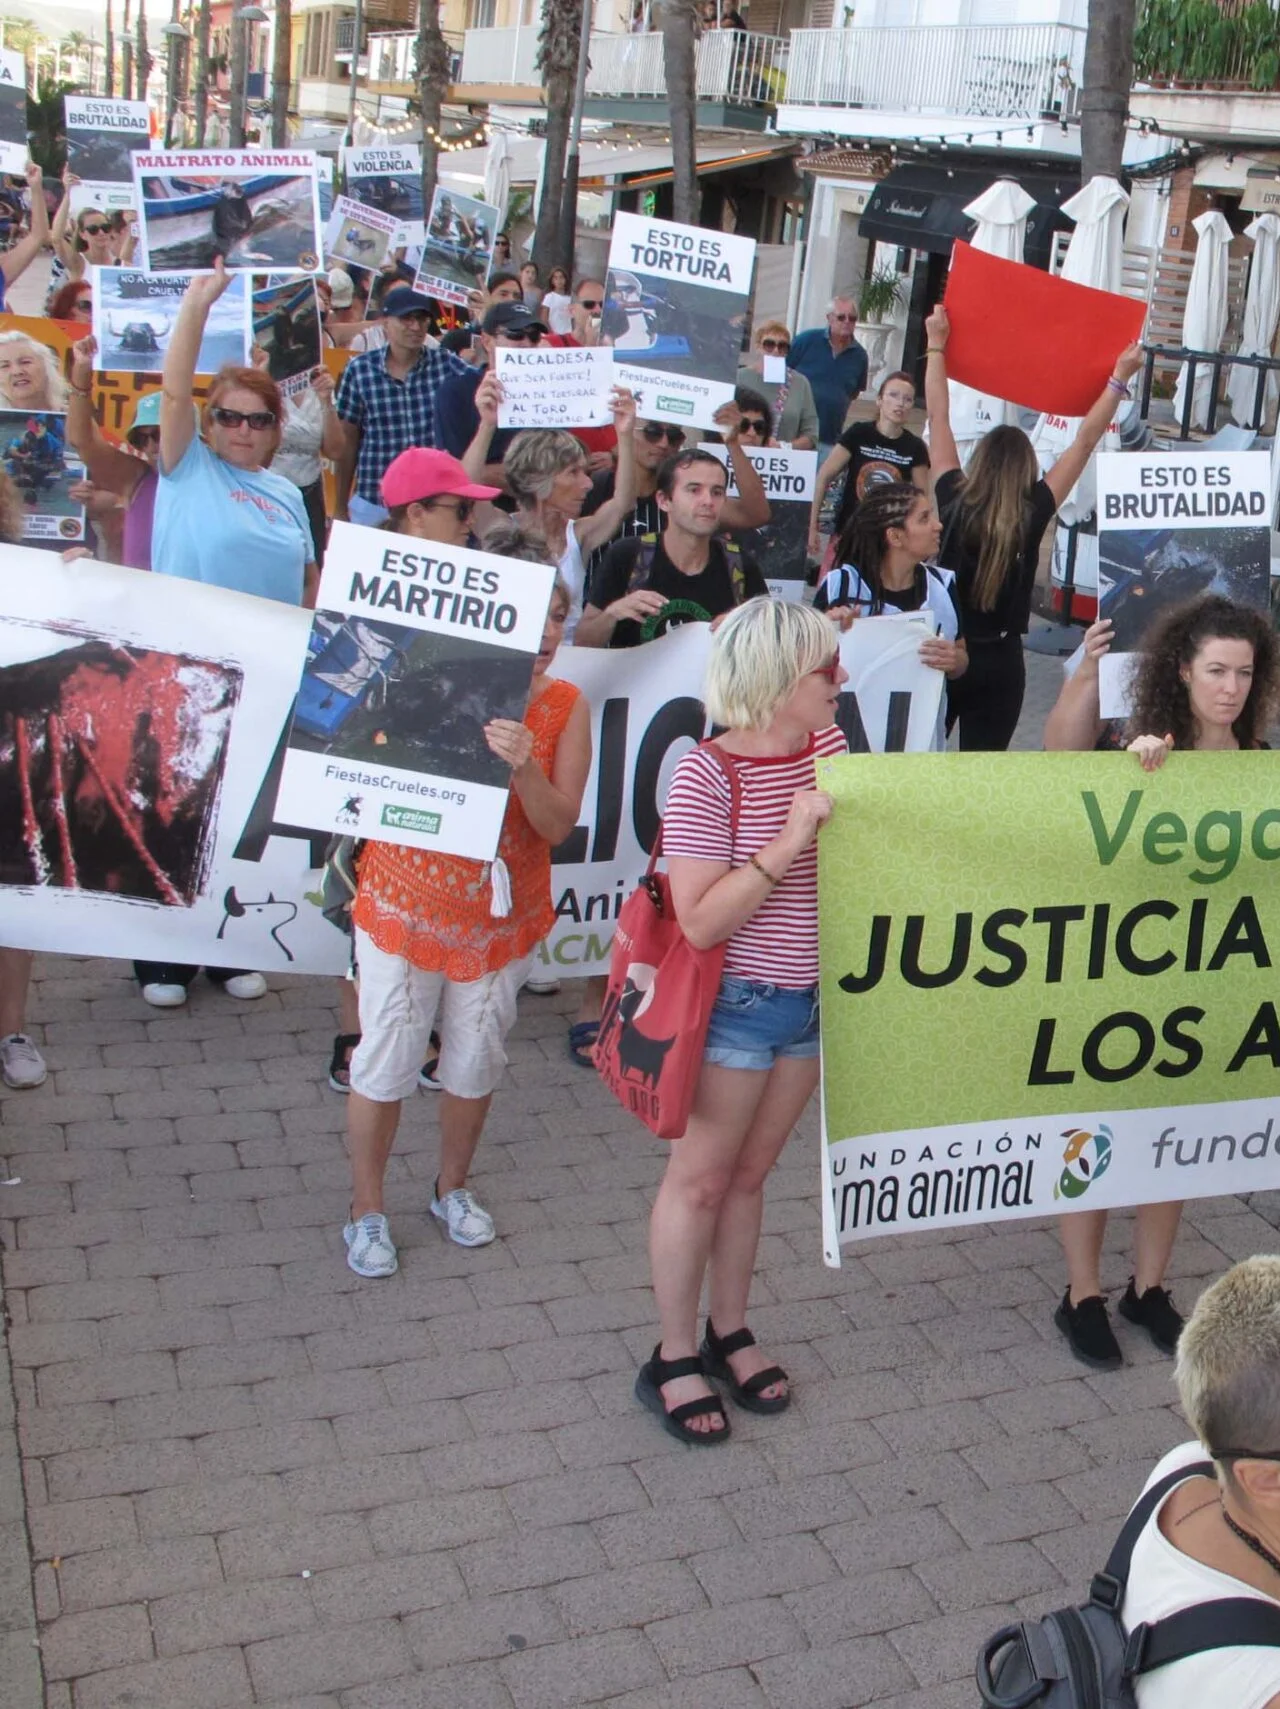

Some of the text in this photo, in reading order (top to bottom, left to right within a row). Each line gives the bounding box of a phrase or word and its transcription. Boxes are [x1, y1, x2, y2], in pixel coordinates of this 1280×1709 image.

[69, 113, 147, 129] BRUTALIDAD
[86, 104, 130, 114] ESTO ES
[136, 155, 312, 168] MALTRATO ANIMAL
[353, 160, 413, 172] VIOLENCIA
[363, 151, 401, 160] ESTO ES
[647, 229, 721, 257] ESTO ES
[630, 244, 731, 283] TORTURA
[504, 352, 594, 365] ALCALDESA
[620, 370, 709, 396] FiestasCrueles.org
[770, 458, 788, 472] ES
[1140, 466, 1231, 488] ESTO ES
[1104, 490, 1265, 519] BRUTALIDAD
[382, 549, 500, 595] ESTO ES
[349, 572, 518, 634] MARTIRIO
[324, 765, 467, 805] FiestasCrueles.org
[838, 896, 1272, 995] JUSTICIA
[1027, 1007, 1206, 1087] LOS
[908, 1159, 1033, 1219] animal
